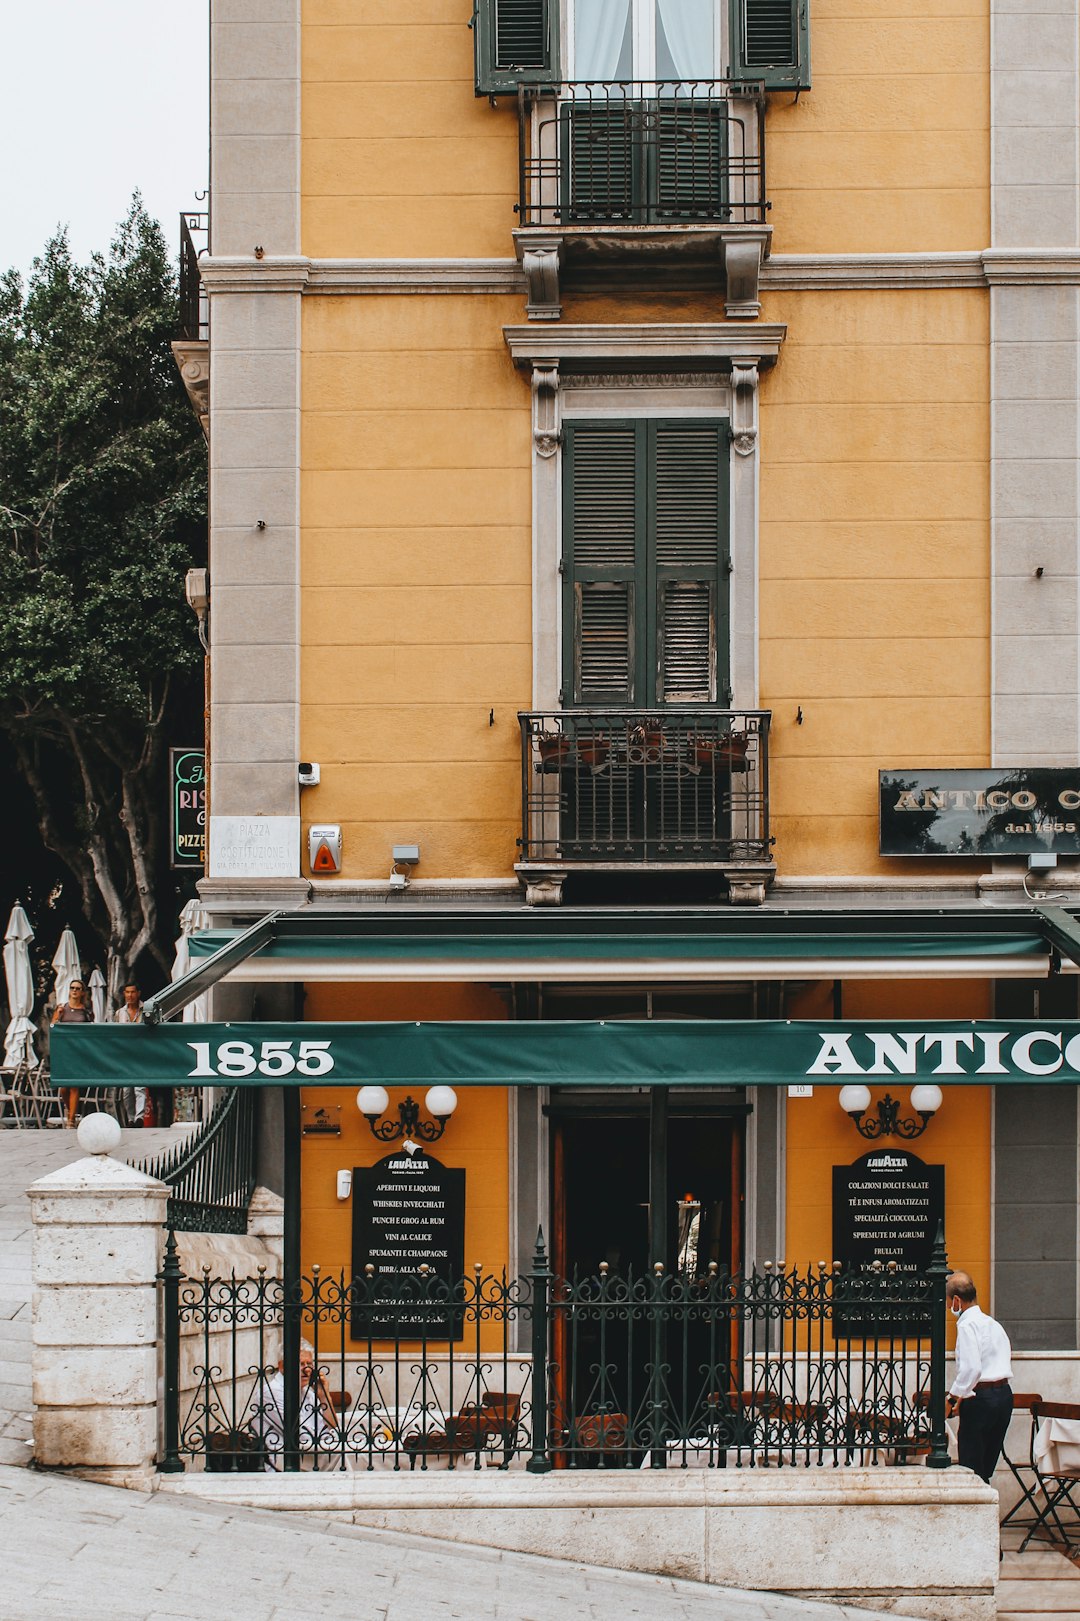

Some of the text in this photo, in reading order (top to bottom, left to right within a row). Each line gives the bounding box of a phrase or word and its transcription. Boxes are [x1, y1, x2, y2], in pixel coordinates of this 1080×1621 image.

[893, 790, 1037, 811] ANTICO
[240, 825, 270, 836] PIAZZA
[1004, 822, 1076, 834] dal 1855
[221, 847, 285, 858] COSTITUZIONE
[186, 1031, 1080, 1077] 1855 ANTIC
[388, 1158, 429, 1169] LAVAZZA
[866, 1155, 908, 1167] LAVAZZA
[413, 1185, 440, 1193] LIQUORI
[372, 1200, 403, 1208] WHISKIES
[857, 1198, 862, 1206] E
[862, 1198, 882, 1206] INFUSI
[883, 1198, 929, 1206] AROMATIZZATI
[400, 1217, 420, 1225] GROG
[889, 1214, 928, 1222] CIOCCOLATA
[384, 1233, 433, 1241] VINI AL CALICE
[852, 1231, 925, 1239] SPREMUTE DI AGRUMI
[368, 1249, 448, 1258] SPUMANTI E CHAMPAGNE
[874, 1247, 903, 1255] FRULLATI
[399, 1265, 416, 1273] ALLA
[860, 1264, 917, 1272] YGT TURALI
